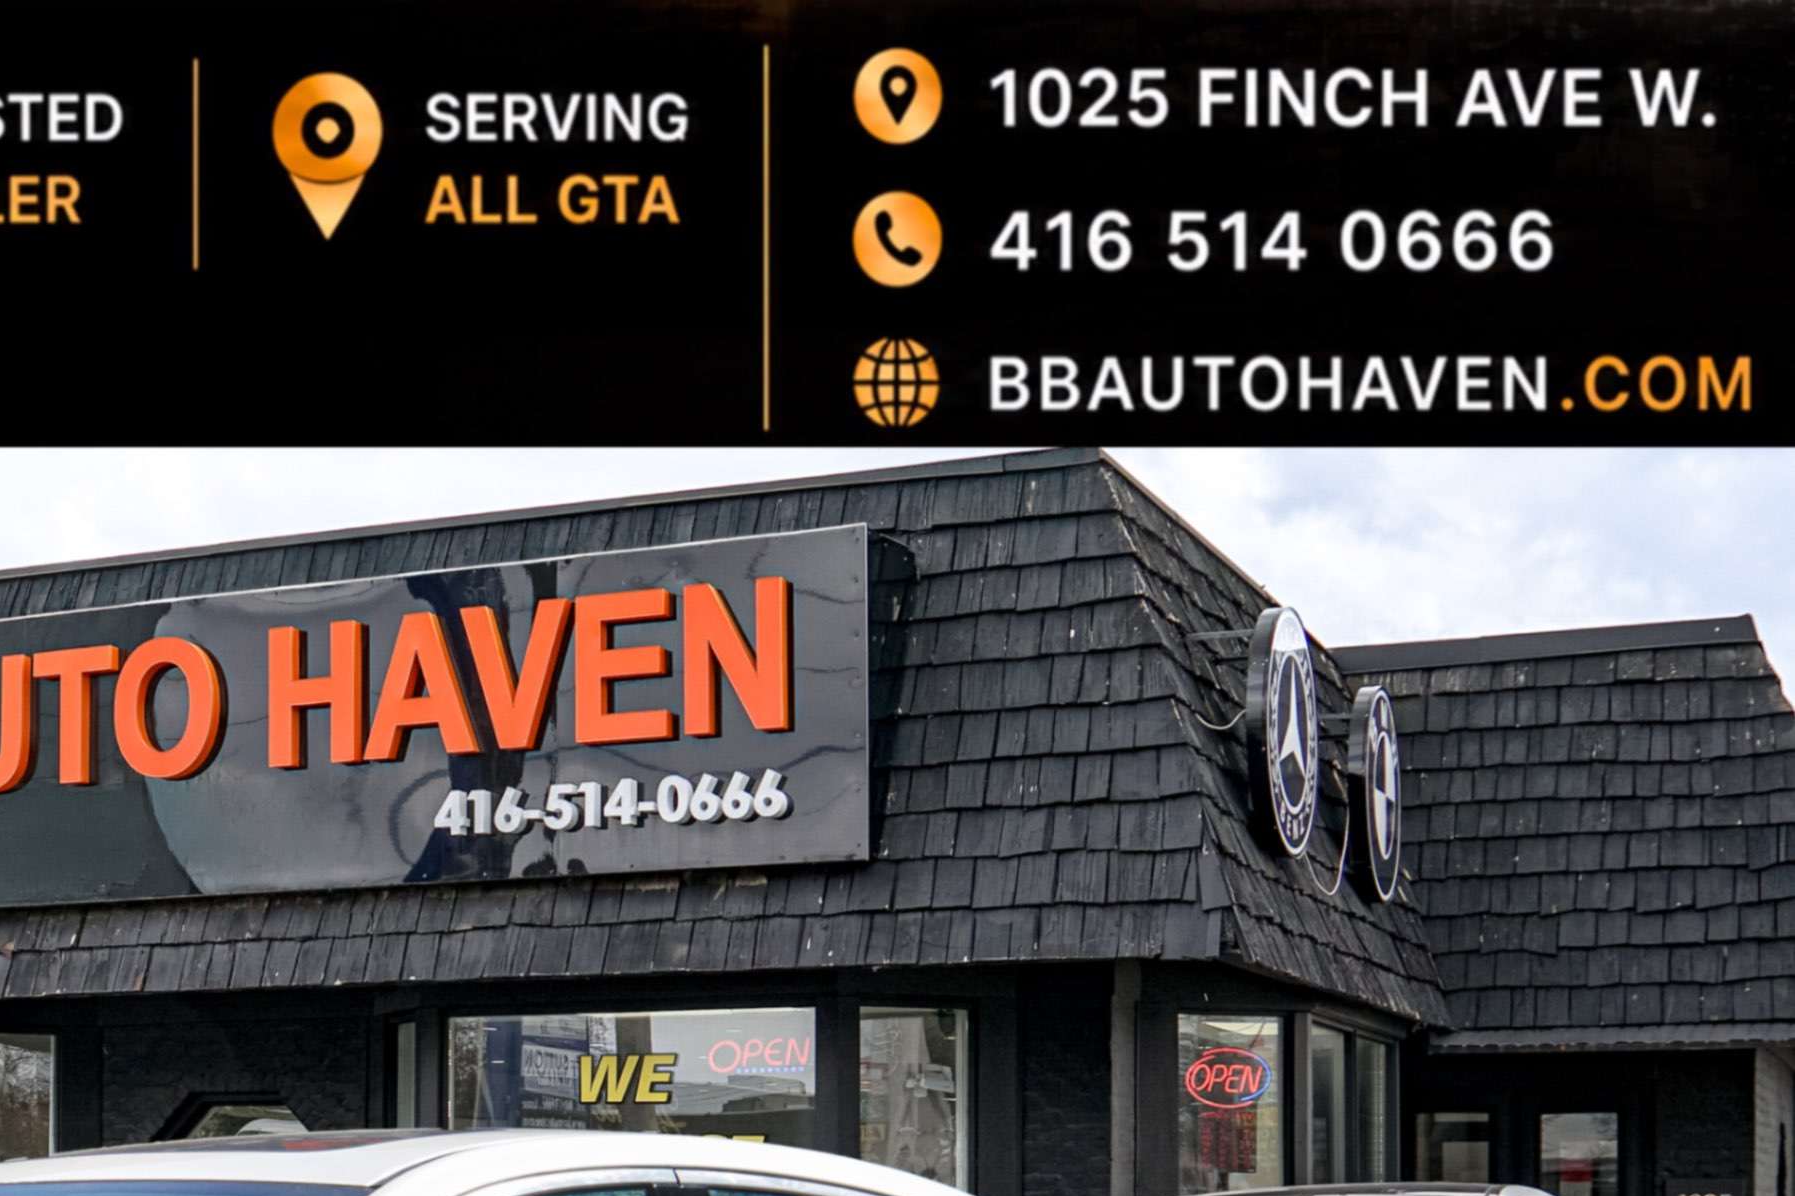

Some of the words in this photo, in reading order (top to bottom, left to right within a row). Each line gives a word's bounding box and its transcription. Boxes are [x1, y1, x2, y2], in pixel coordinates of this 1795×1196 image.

[268, 577, 794, 768] HAVEN
[434, 768, 794, 836] 416-514-0666
[580, 1053, 677, 1103] WE
[709, 1038, 810, 1072] OPEN
[1191, 1064, 1263, 1093] OPEN
